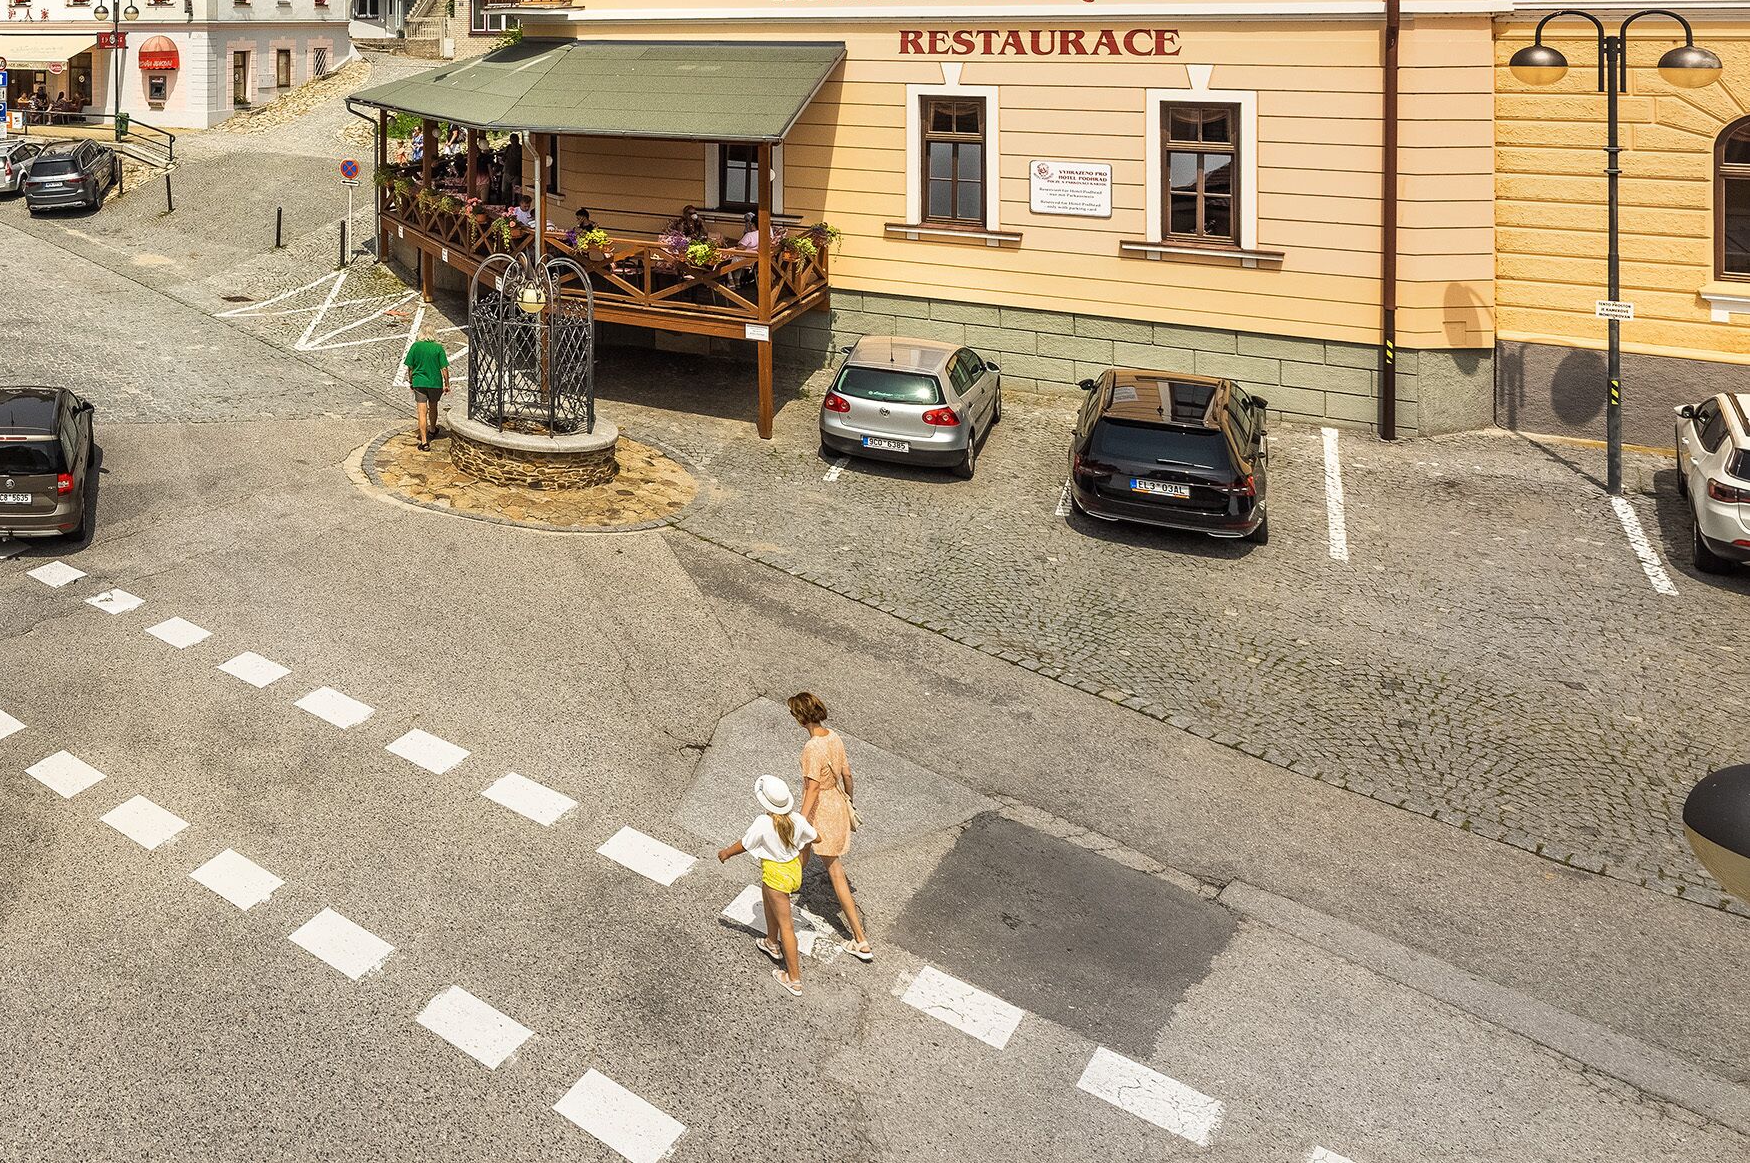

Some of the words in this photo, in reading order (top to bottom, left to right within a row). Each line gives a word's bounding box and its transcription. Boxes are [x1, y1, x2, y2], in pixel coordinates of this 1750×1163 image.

[898, 28, 1182, 57] RESTAURACE
[888, 441, 906, 449] 6385
[1138, 481, 1155, 490] EL3
